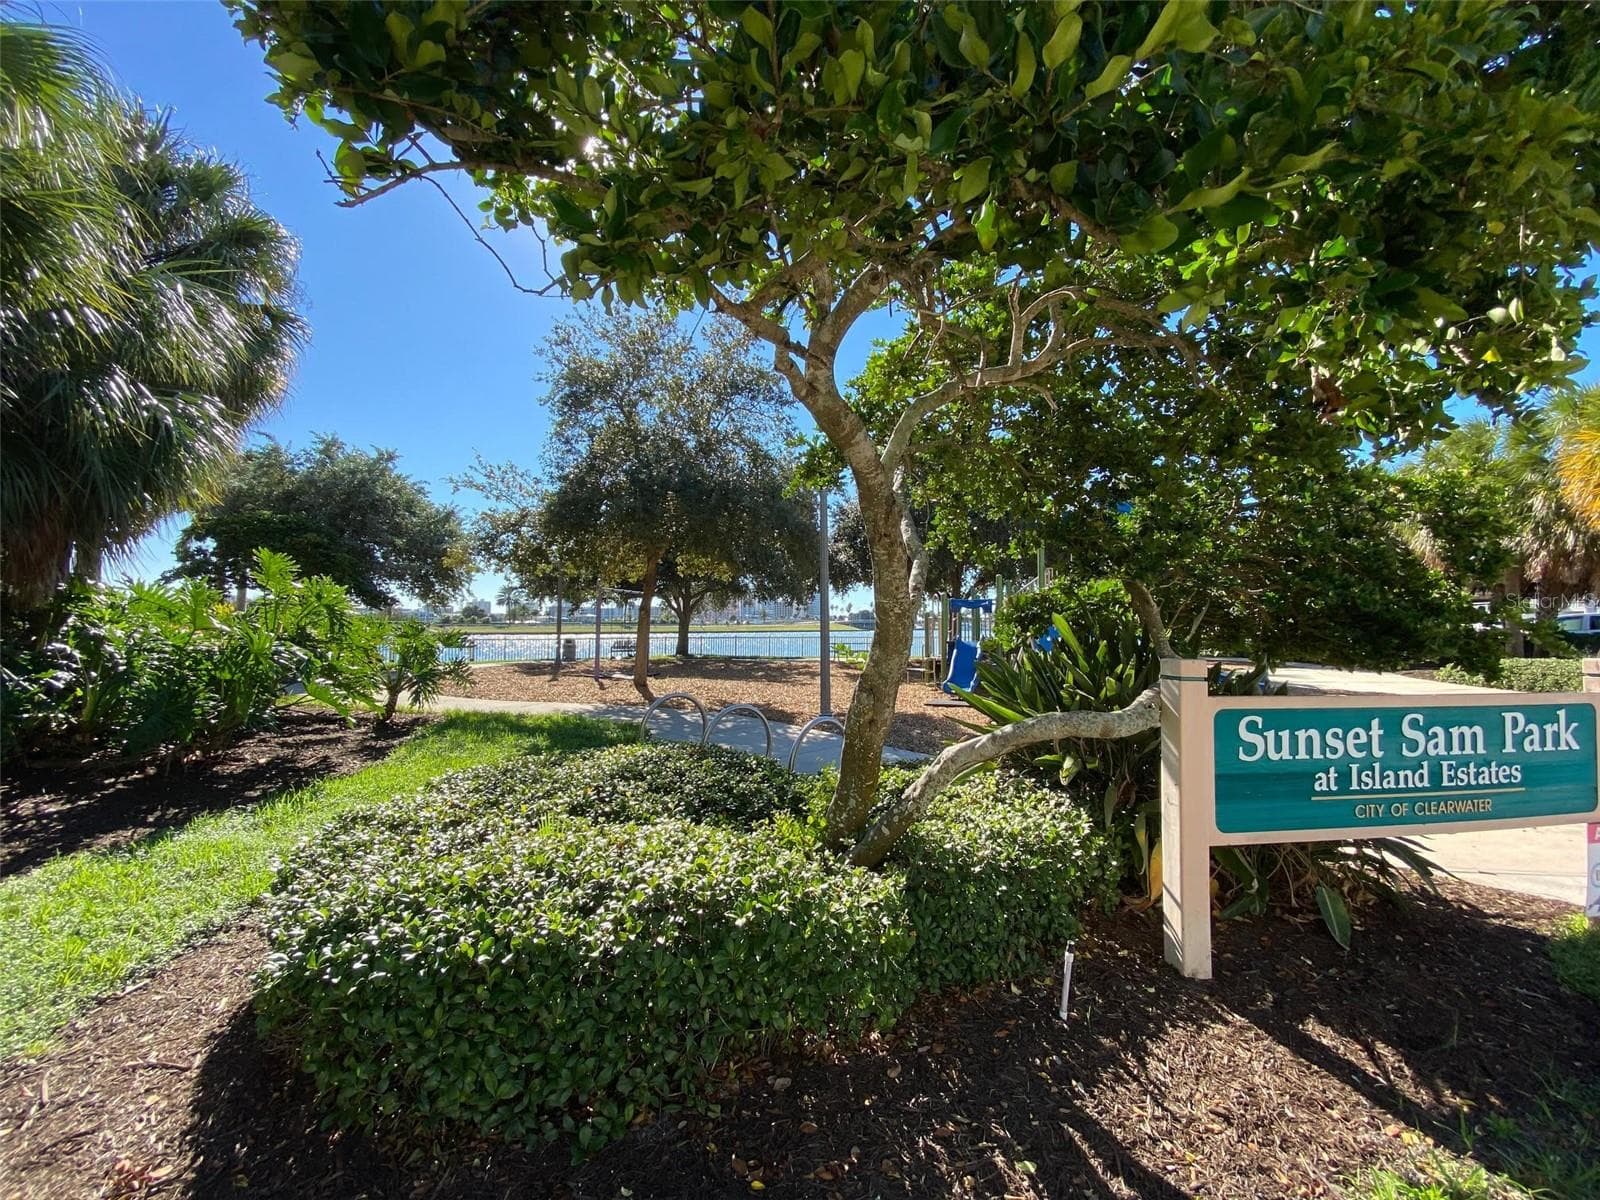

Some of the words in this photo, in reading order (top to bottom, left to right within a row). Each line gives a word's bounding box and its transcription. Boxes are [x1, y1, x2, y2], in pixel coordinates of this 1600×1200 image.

[1238, 715, 1385, 762] Sunset
[1401, 713, 1487, 758] Sam
[1501, 708, 1580, 753] Park
[1313, 766, 1338, 791] at
[1349, 761, 1430, 790] Island
[1440, 760, 1522, 786] Estates
[1355, 804, 1384, 819] CITY
[1391, 802, 1409, 817] OF
[1414, 798, 1492, 816] CLEARWATER
